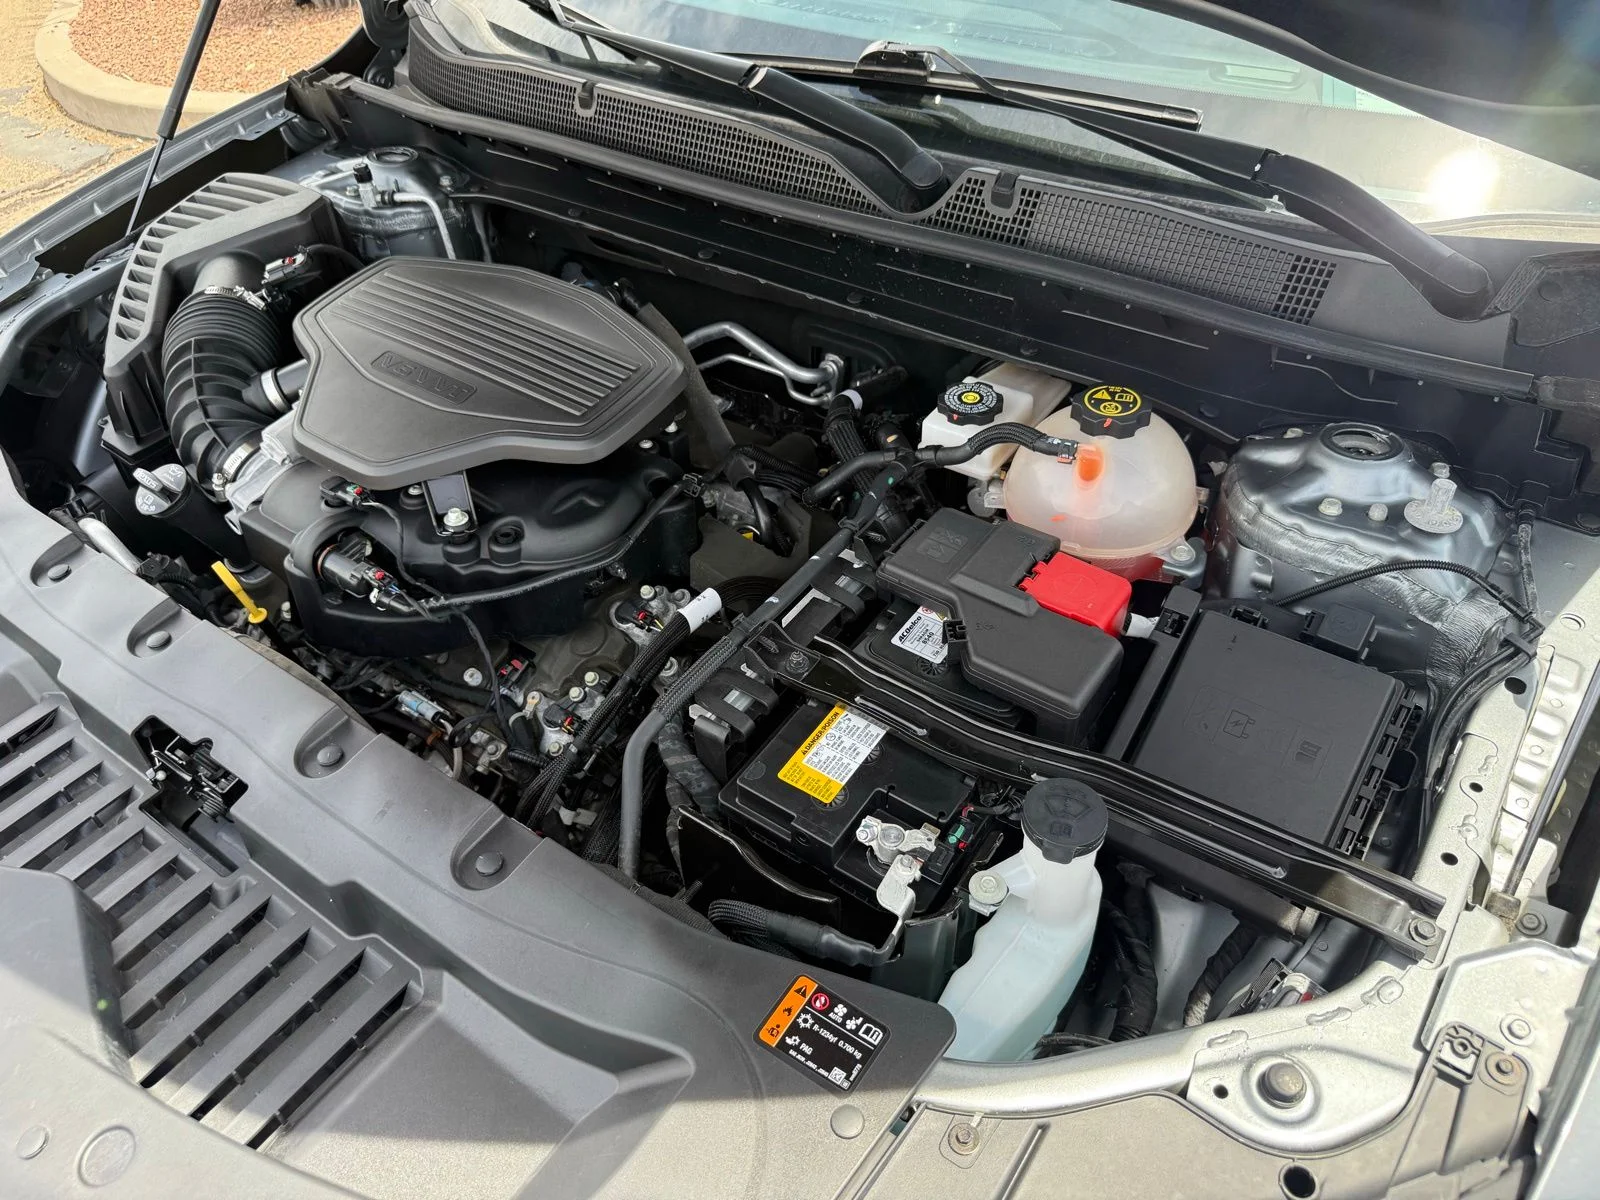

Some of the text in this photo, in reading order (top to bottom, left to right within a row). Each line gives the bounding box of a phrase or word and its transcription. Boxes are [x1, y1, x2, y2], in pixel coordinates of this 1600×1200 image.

[828, 1012, 843, 1023] AUTO
[799, 1042, 814, 1055] PAG
[812, 1024, 862, 1060] R-1234yf 0.700 kg
